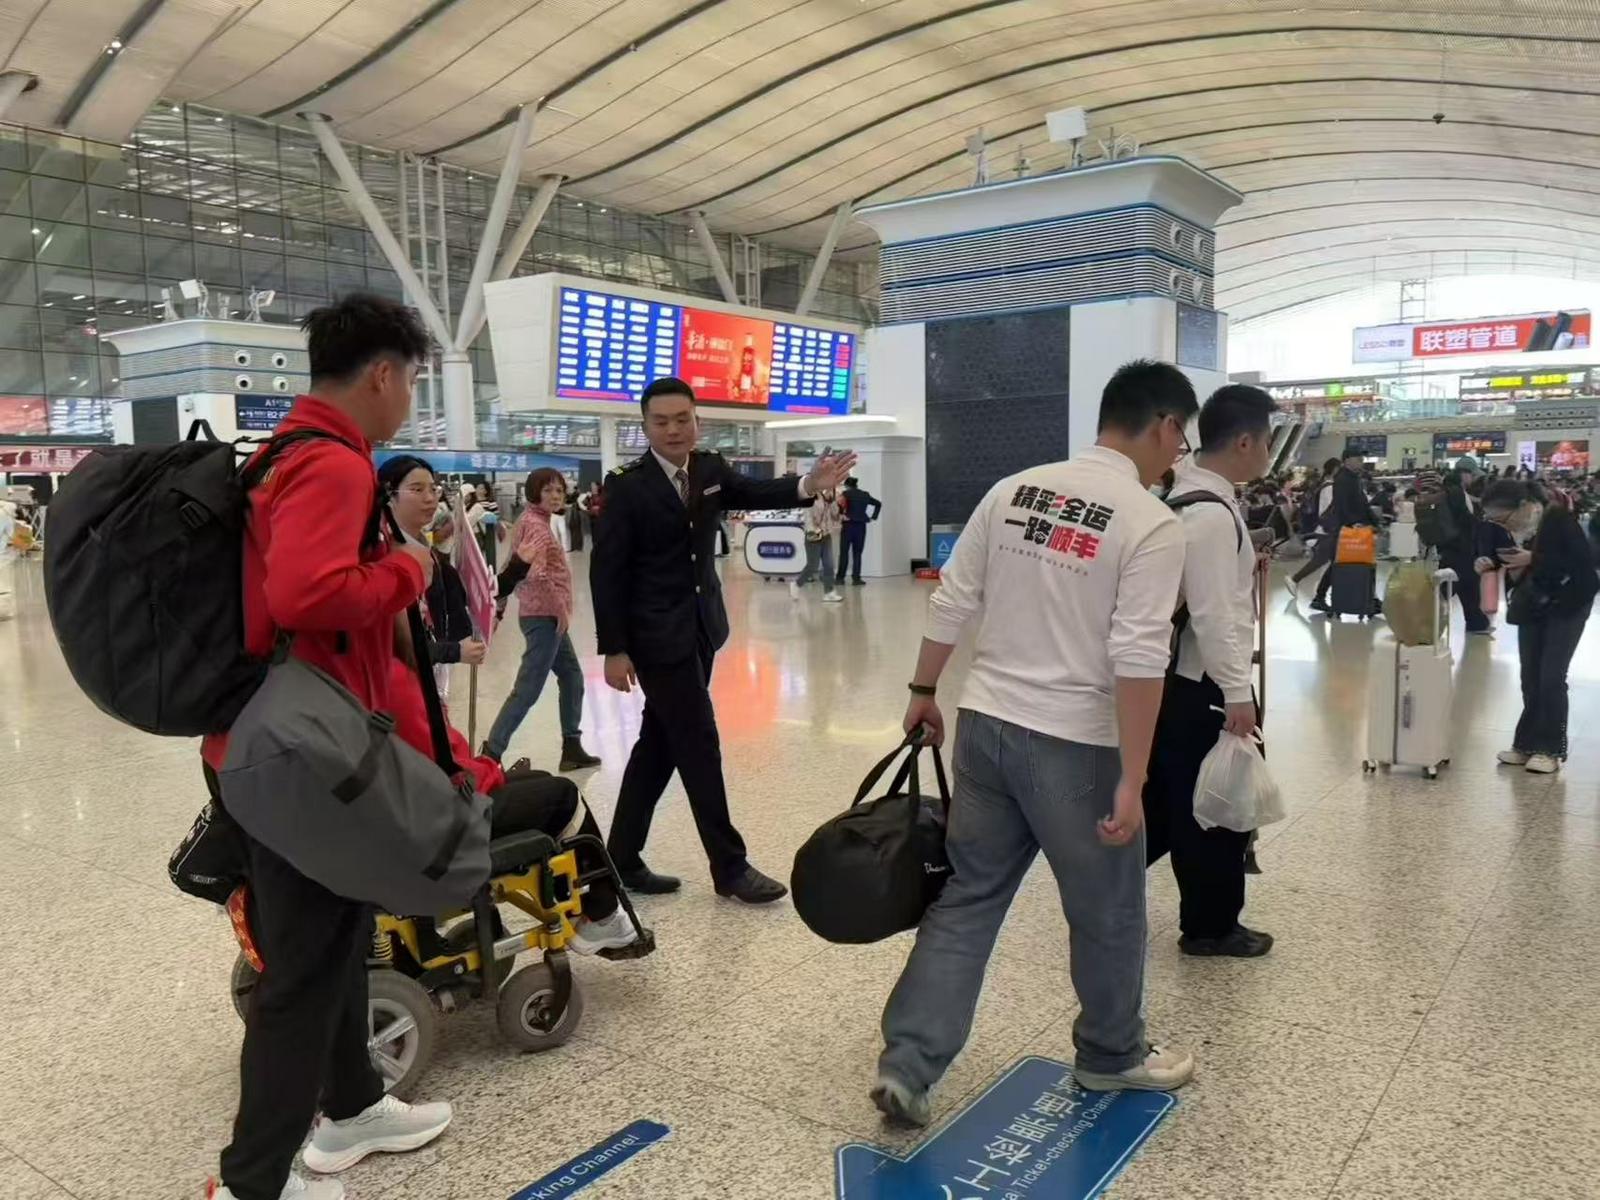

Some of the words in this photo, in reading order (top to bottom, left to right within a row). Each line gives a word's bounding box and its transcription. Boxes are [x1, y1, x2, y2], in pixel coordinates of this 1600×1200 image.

[1420, 325, 1518, 351] 联塑管道
[1010, 485, 1115, 532] 精彩全运
[1004, 516, 1100, 559] 一路顺丰
[571, 1134, 641, 1176] Channel
[1012, 1119, 1094, 1189] Ticket-checking
[1081, 1089, 1121, 1119] Channe
